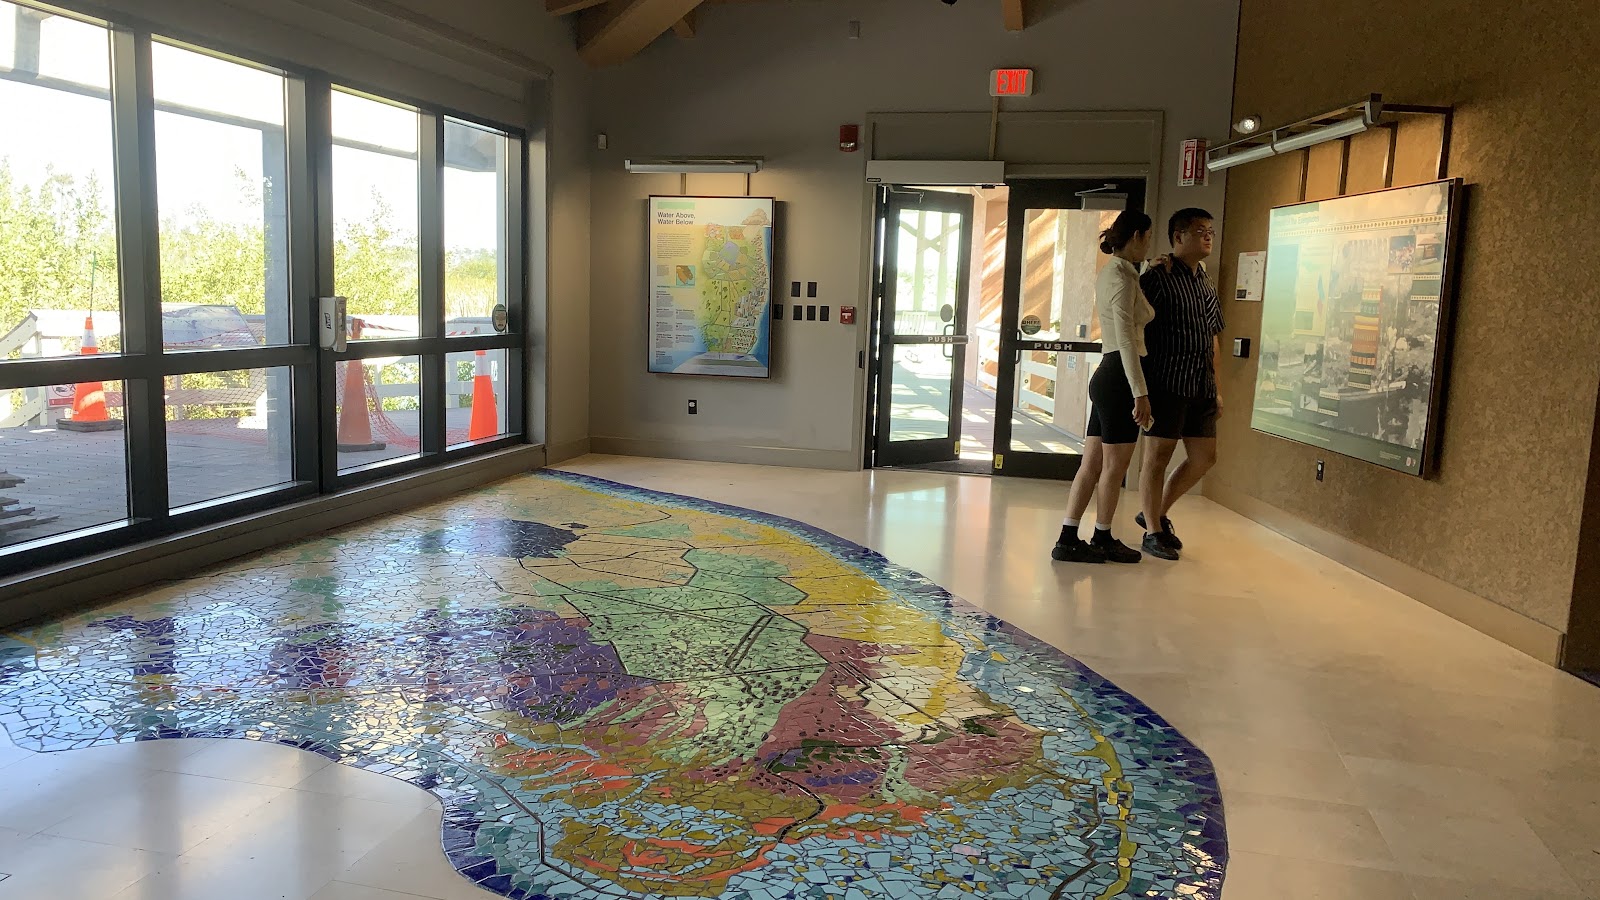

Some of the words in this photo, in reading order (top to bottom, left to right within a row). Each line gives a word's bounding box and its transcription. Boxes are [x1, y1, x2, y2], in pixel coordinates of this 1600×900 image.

[997, 70, 1028, 94] EXIT
[675, 212, 696, 220] Above,
[1034, 342, 1073, 351] PUSH
